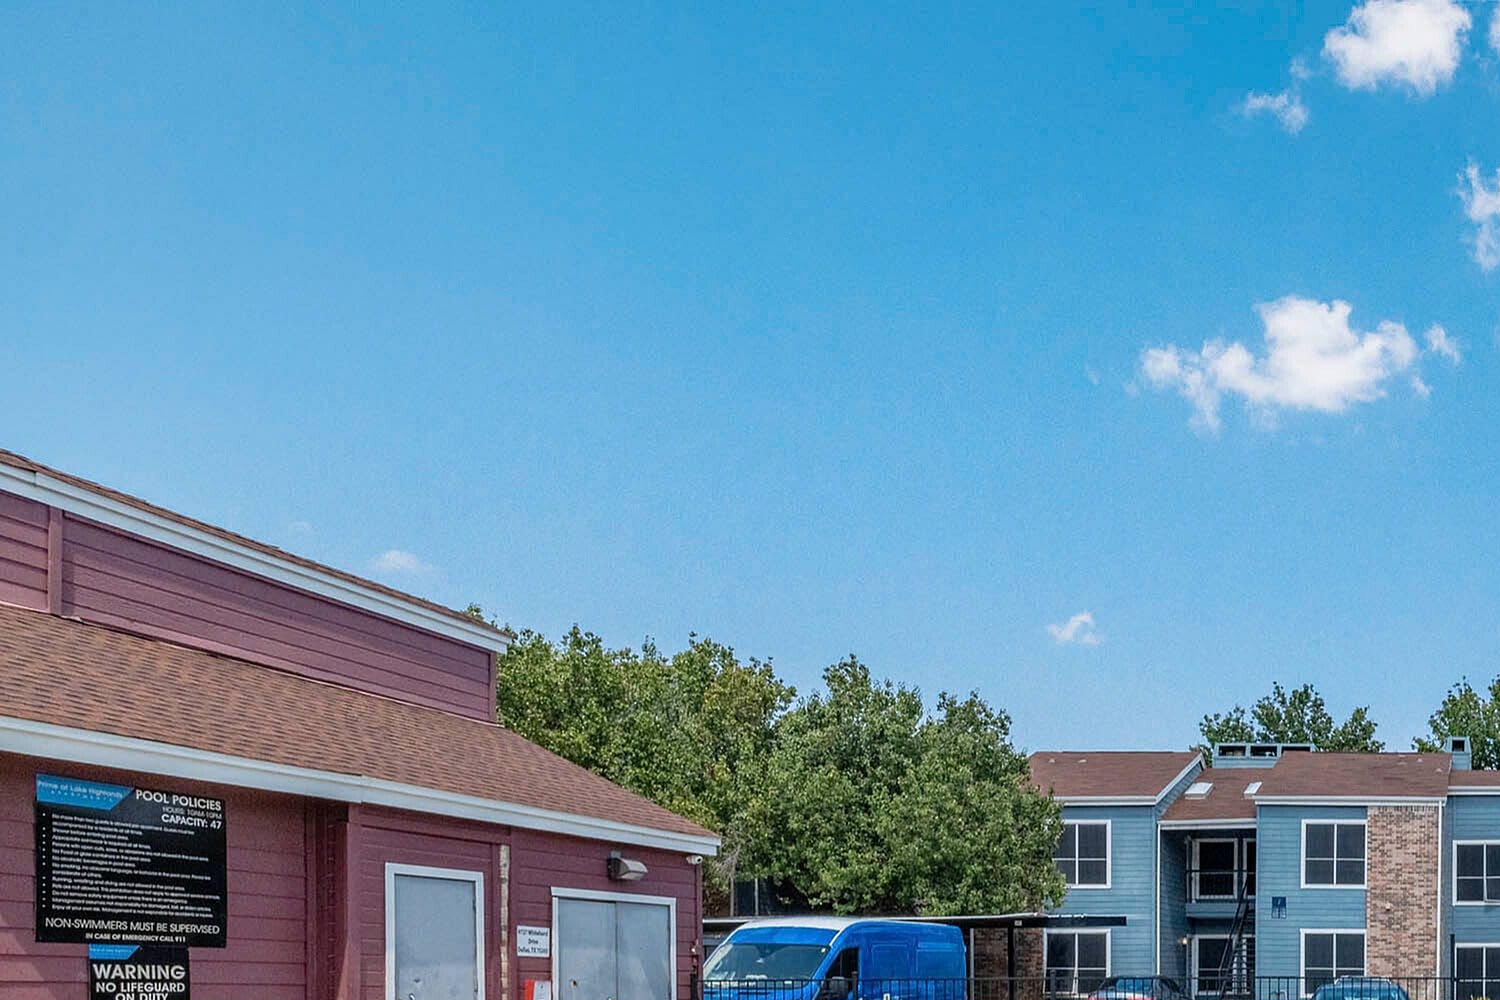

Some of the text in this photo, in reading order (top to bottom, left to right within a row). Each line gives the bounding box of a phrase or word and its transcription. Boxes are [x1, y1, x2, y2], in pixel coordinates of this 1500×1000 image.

[135, 789, 222, 811] POOL POLICIES
[161, 813, 208, 828] CAPACITY:
[210, 820, 222, 830] 47
[45, 917, 220, 934] NON-SWIMMERS MUST BE SUPERVISED
[122, 934, 158, 942] EMERGENCY
[92, 964, 186, 980] WARNING
[96, 982, 186, 993] NO LIFEGUARD
